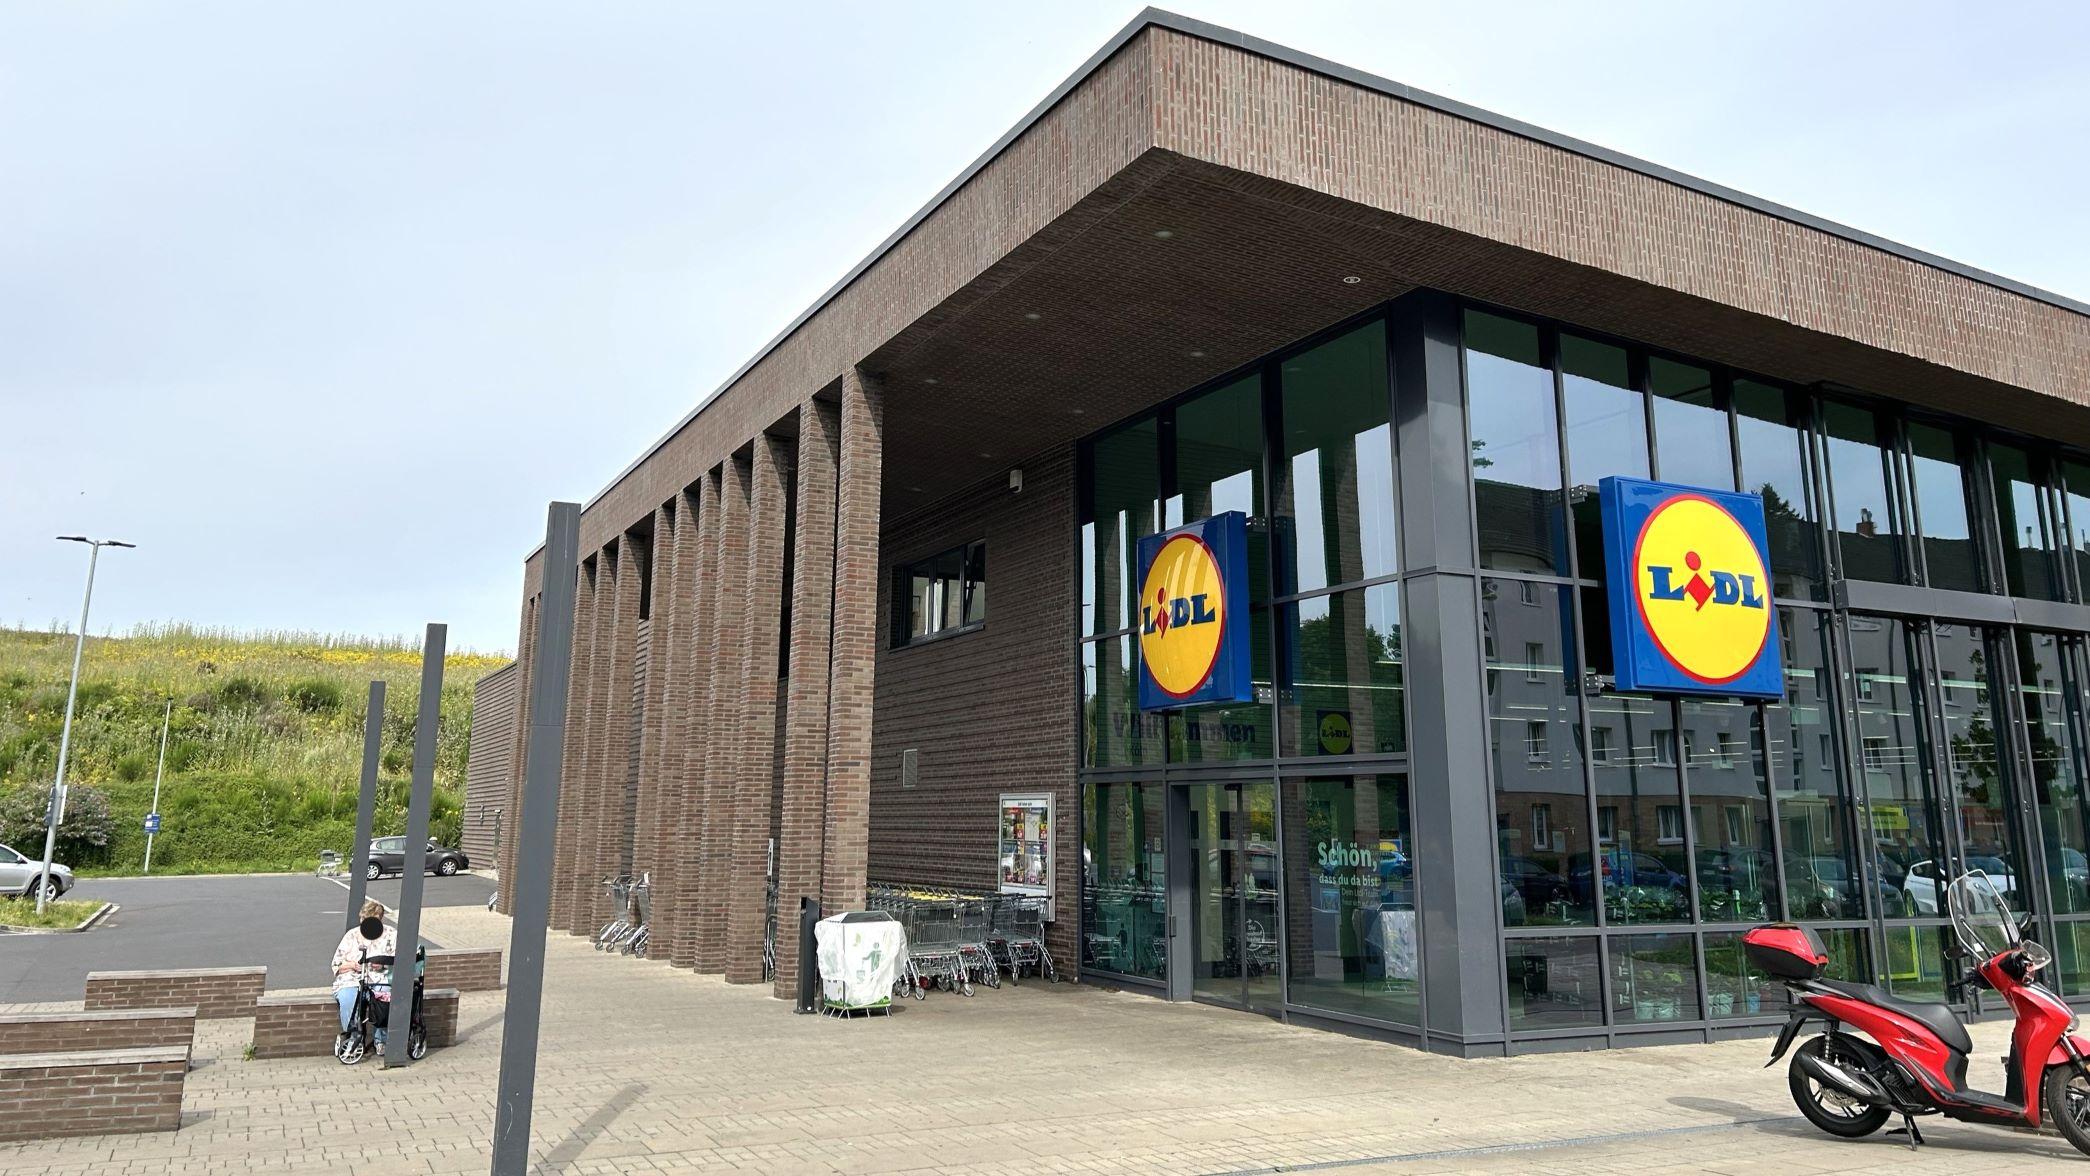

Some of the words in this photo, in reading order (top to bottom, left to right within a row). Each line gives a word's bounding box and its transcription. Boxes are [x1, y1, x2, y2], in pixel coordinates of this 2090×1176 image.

[1317, 841, 1378, 872] Schön,
[1319, 873, 1337, 885] dass
[1338, 873, 1349, 886] du
[1350, 874, 1361, 886] da
[1362, 875, 1378, 887] bist
